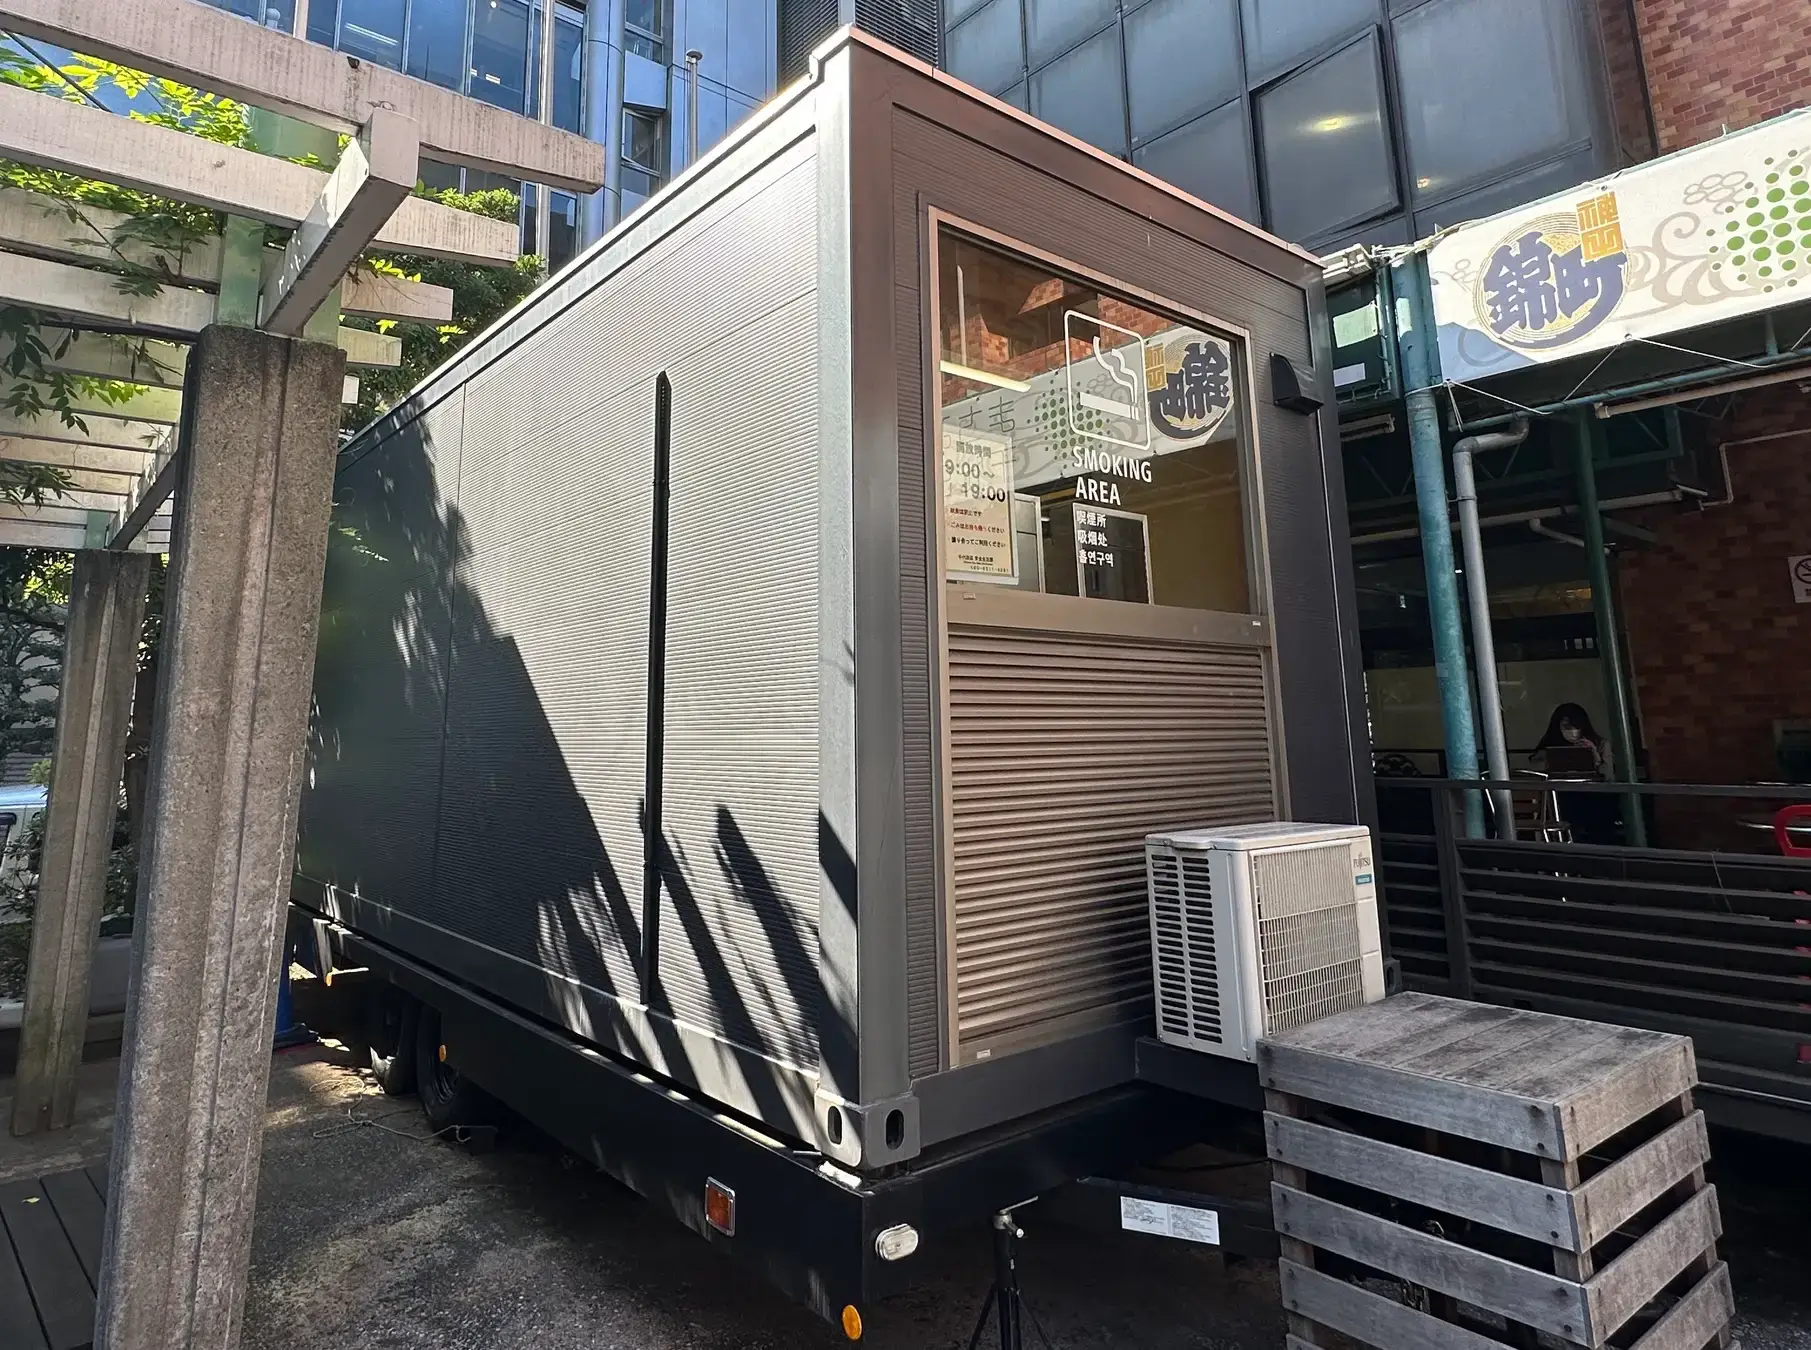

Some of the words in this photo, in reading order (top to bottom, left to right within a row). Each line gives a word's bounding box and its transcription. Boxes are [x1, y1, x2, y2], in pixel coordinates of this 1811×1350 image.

[1073, 446, 1151, 483] SMOKING
[961, 482, 1006, 502] 19:00
[1076, 476, 1121, 506] AREA
[1077, 510, 1107, 528] 喫煙所
[1077, 530, 1108, 547] 吸烟处
[1079, 549, 1114, 567] 흡연구역
